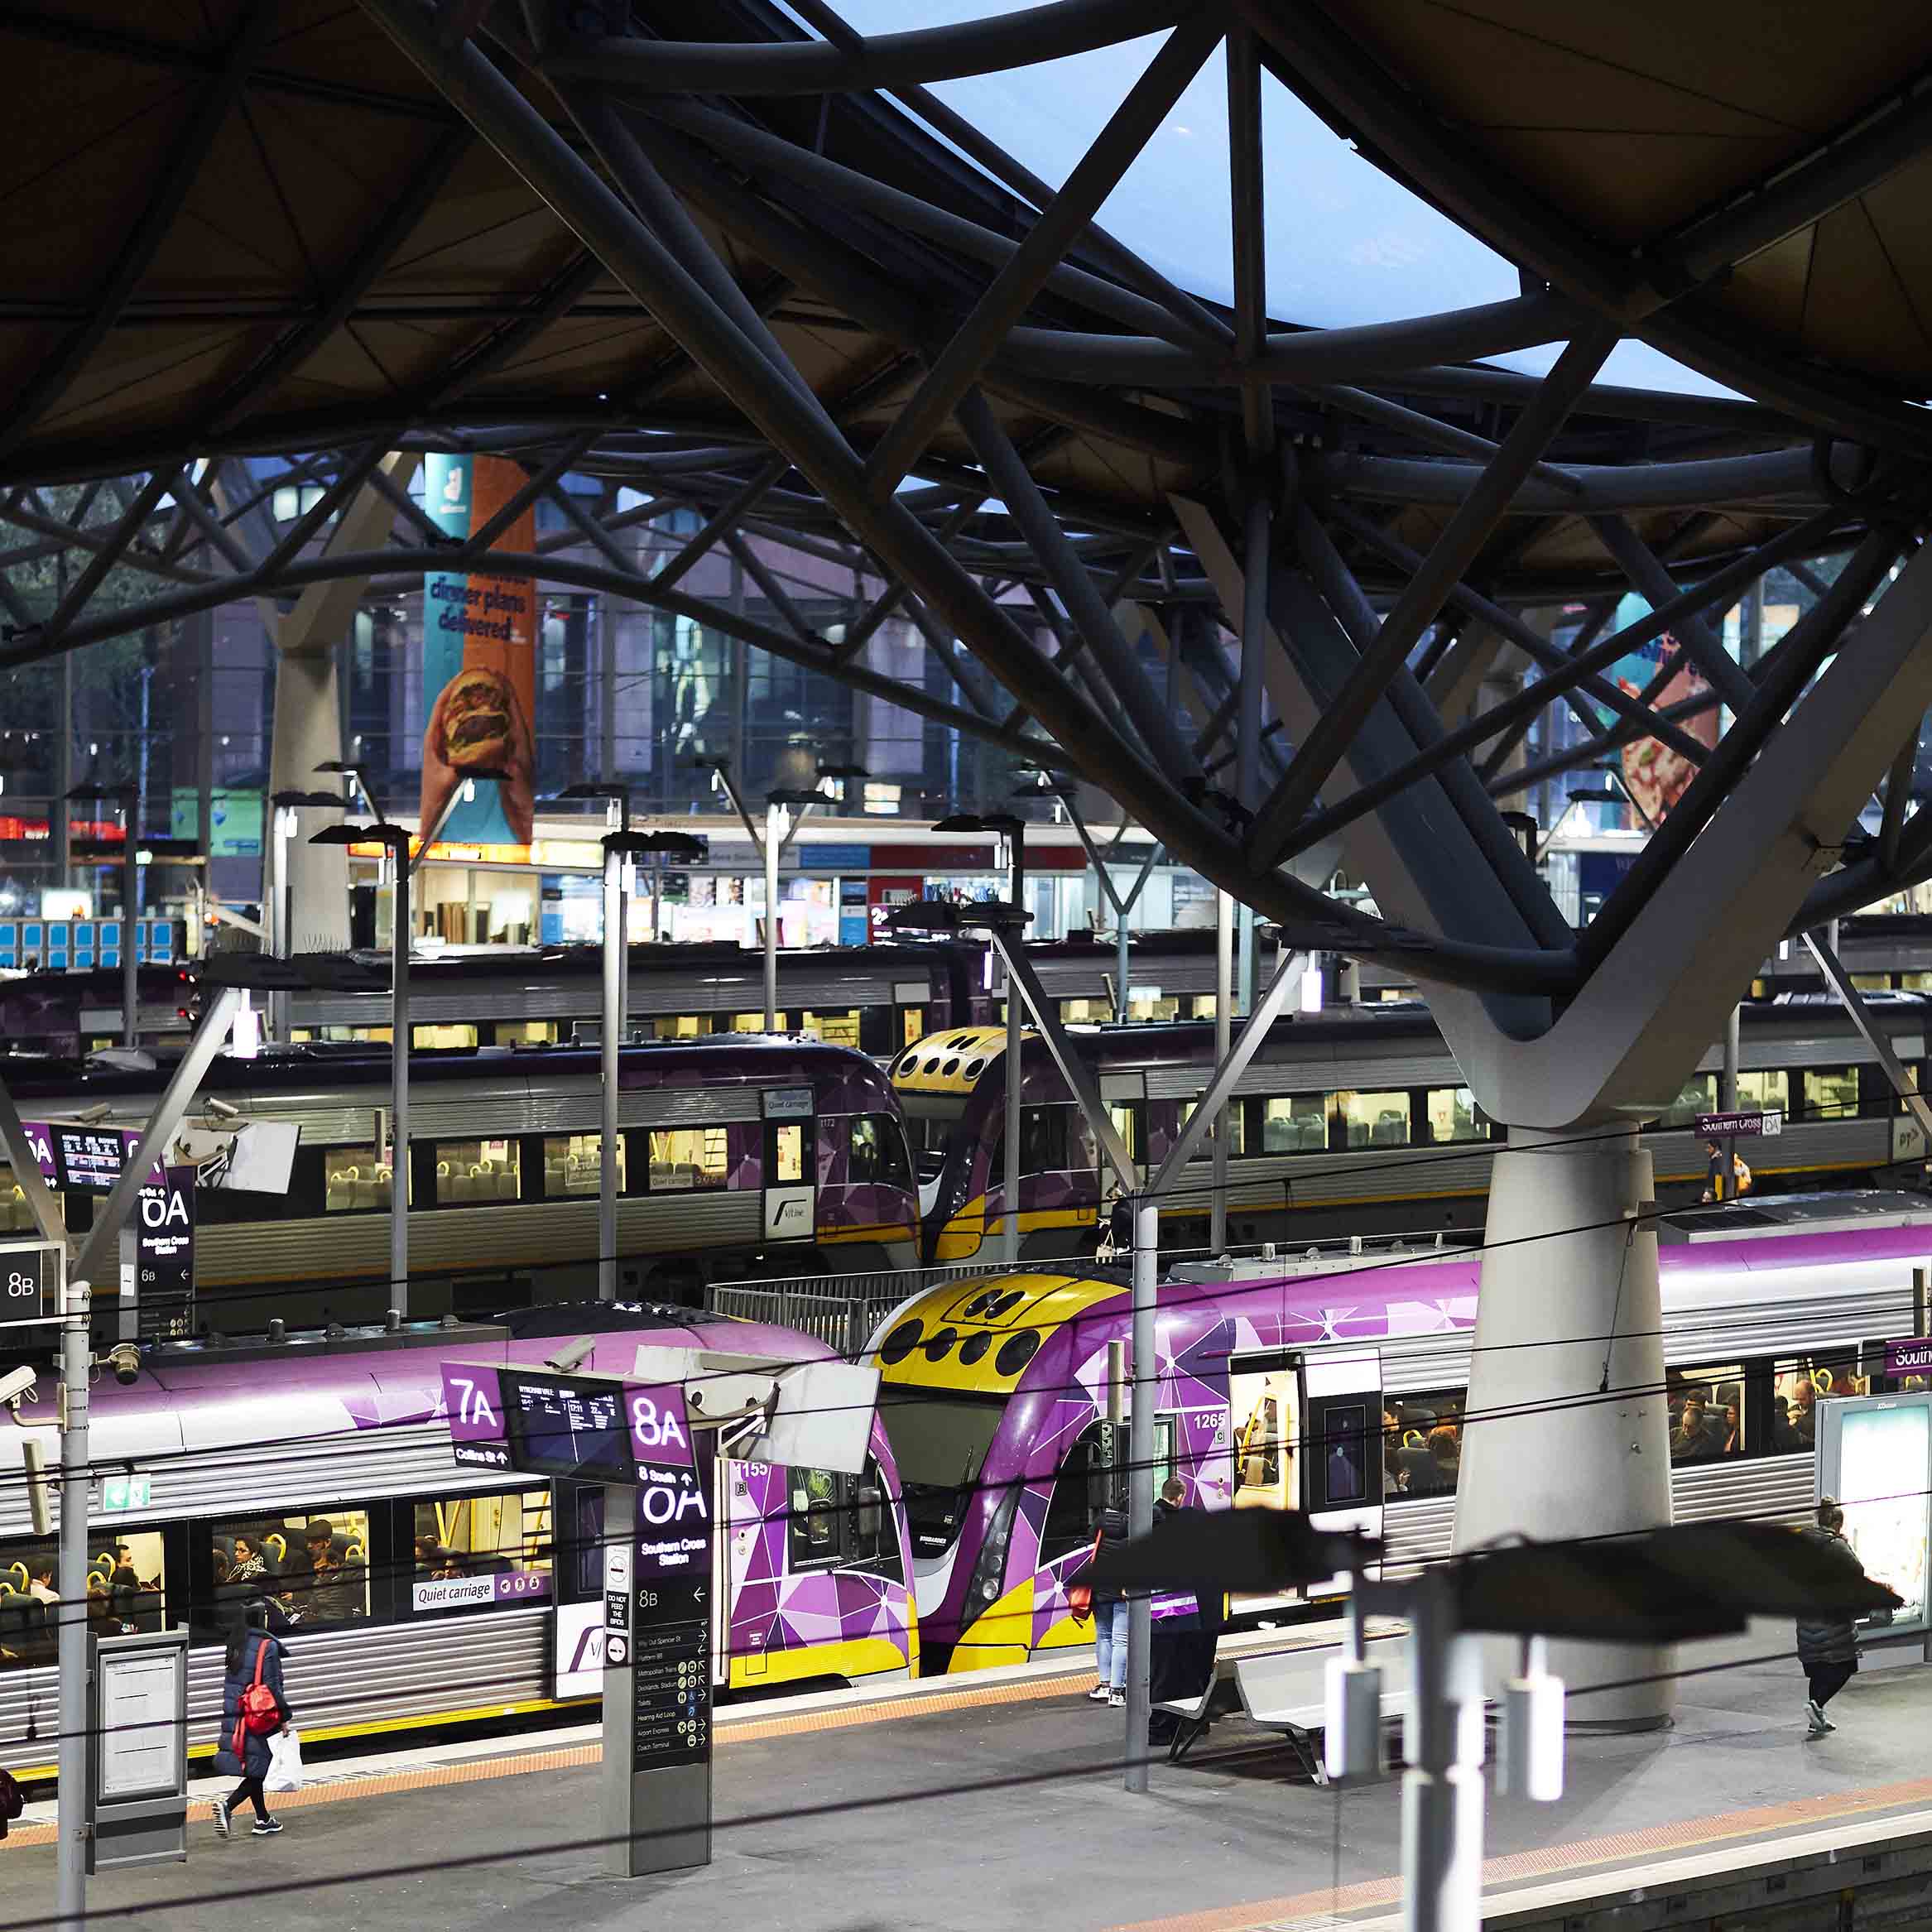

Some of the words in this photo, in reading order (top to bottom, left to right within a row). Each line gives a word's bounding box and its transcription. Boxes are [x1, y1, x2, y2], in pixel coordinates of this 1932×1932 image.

[430, 576, 480, 605] dinner
[483, 584, 526, 614] plans
[1739, 1117, 1761, 1130] Cross
[142, 1269, 156, 1281] 6B
[7, 1272, 34, 1297] 8B
[449, 1378, 497, 1427] 7A
[632, 1397, 687, 1449] 8A
[1194, 1412, 1225, 1430] 1265
[456, 1448, 485, 1462] Collins
[734, 1461, 768, 1478] 1155
[642, 1541, 680, 1555] Southern
[680, 1538, 707, 1551] Cross
[659, 1553, 690, 1566] Station
[418, 1587, 446, 1603] Quiet
[449, 1583, 490, 1598] carriage
[639, 1589, 657, 1608] 8B
[637, 1743, 651, 1752] Coach
[651, 1741, 670, 1749] Terminal
